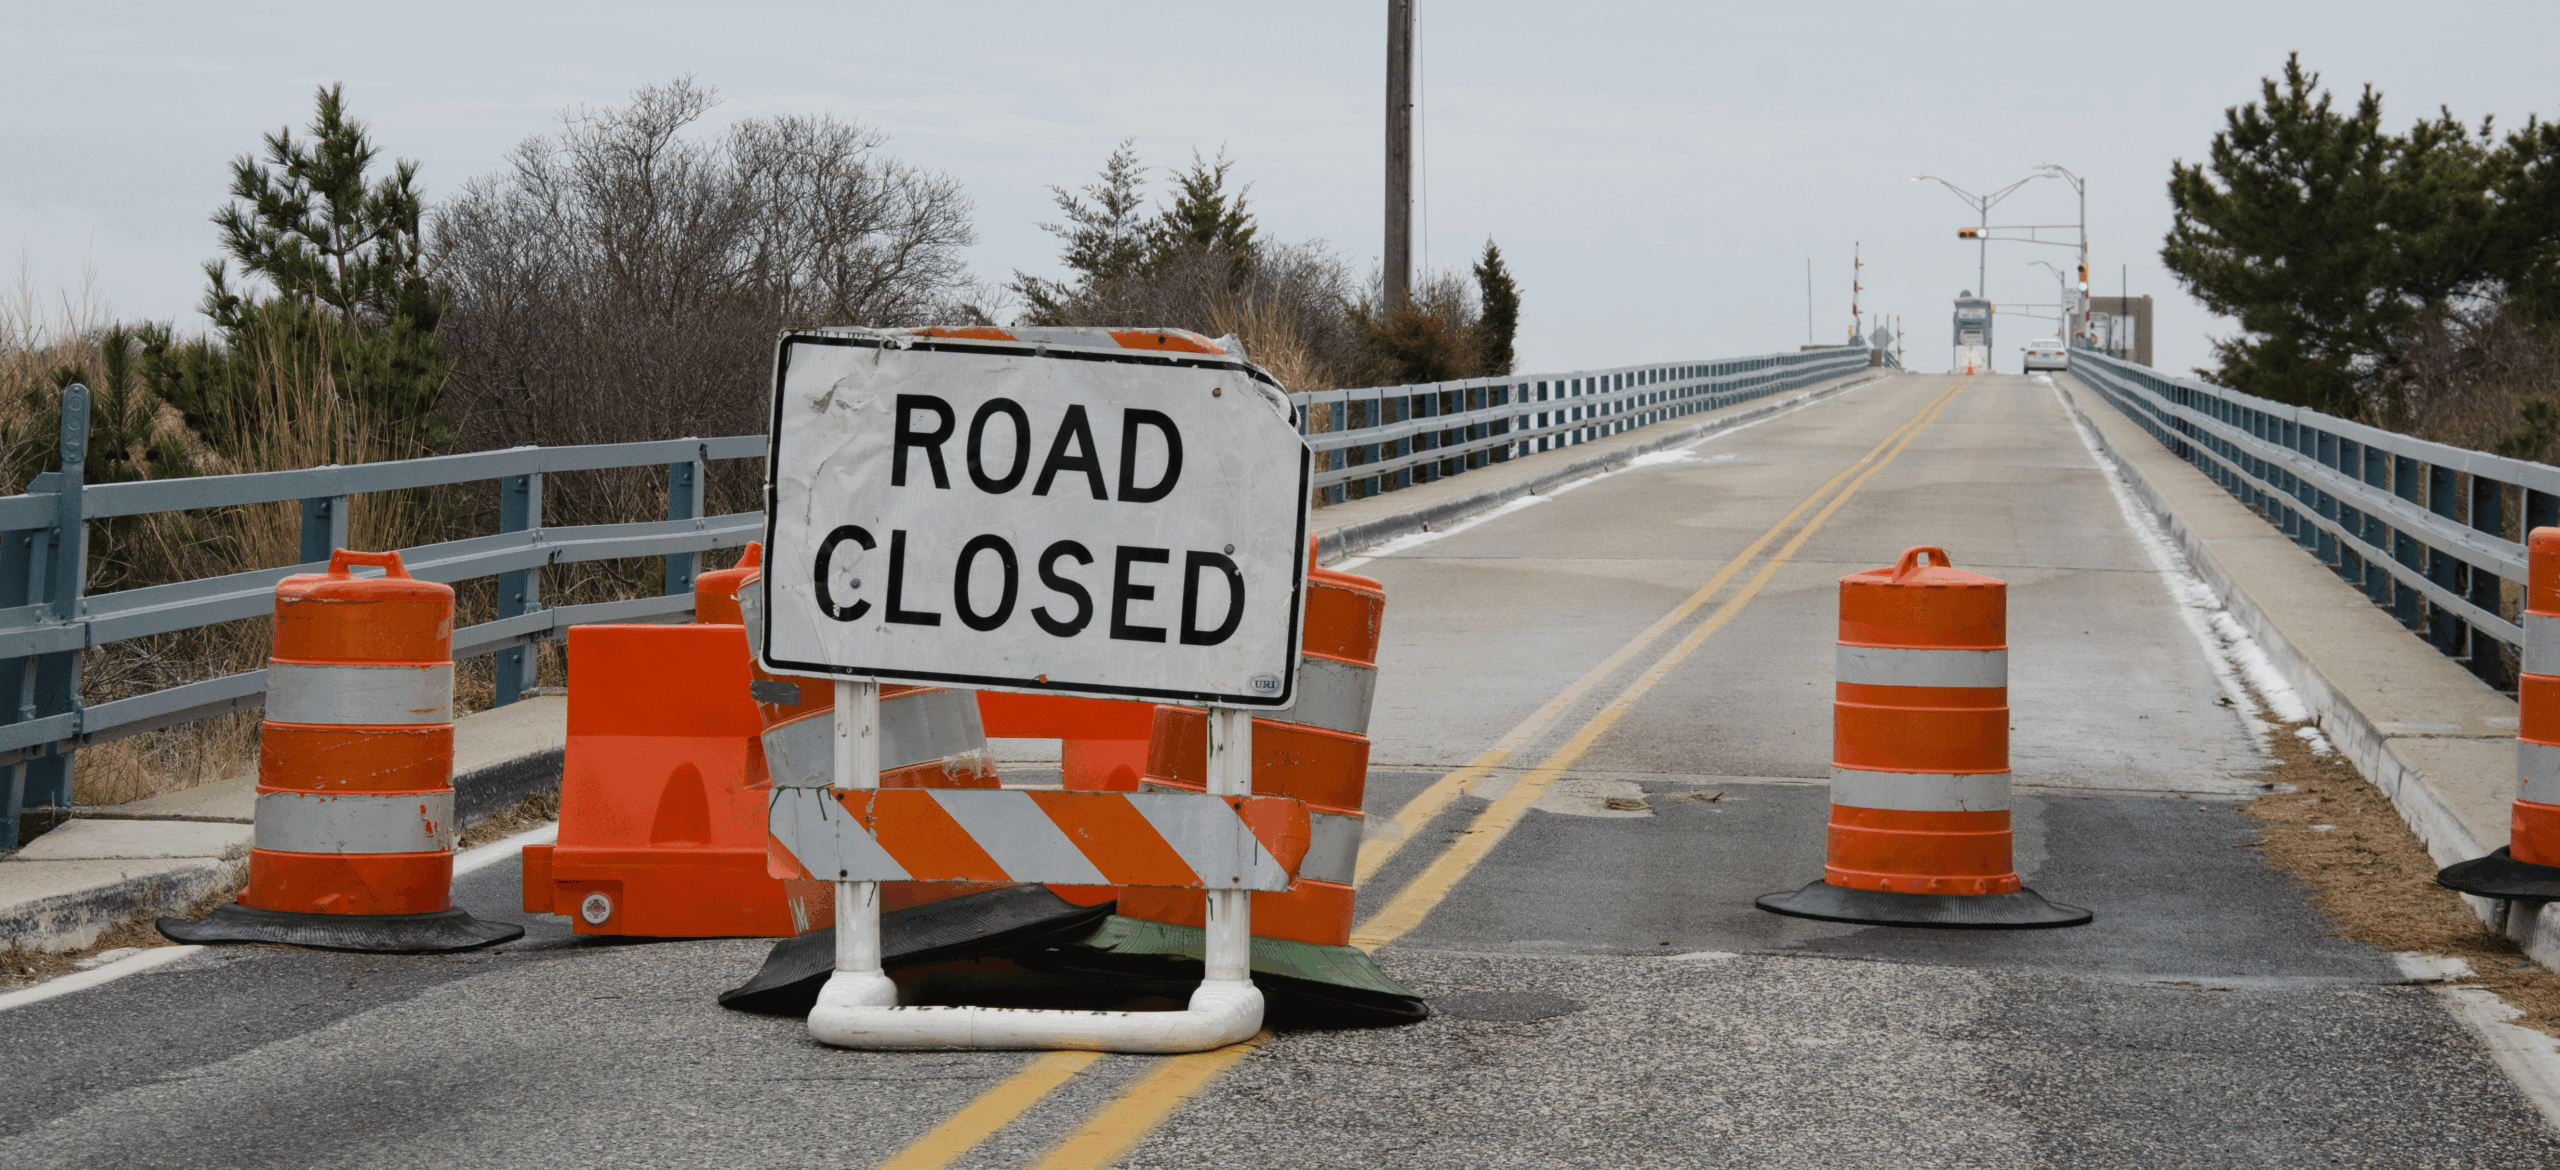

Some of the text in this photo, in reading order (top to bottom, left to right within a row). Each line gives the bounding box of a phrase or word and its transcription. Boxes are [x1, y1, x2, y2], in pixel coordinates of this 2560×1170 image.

[891, 394, 1183, 503] ROAD
[814, 525, 1245, 646] CLOSED
[1255, 680, 1276, 689] URI
